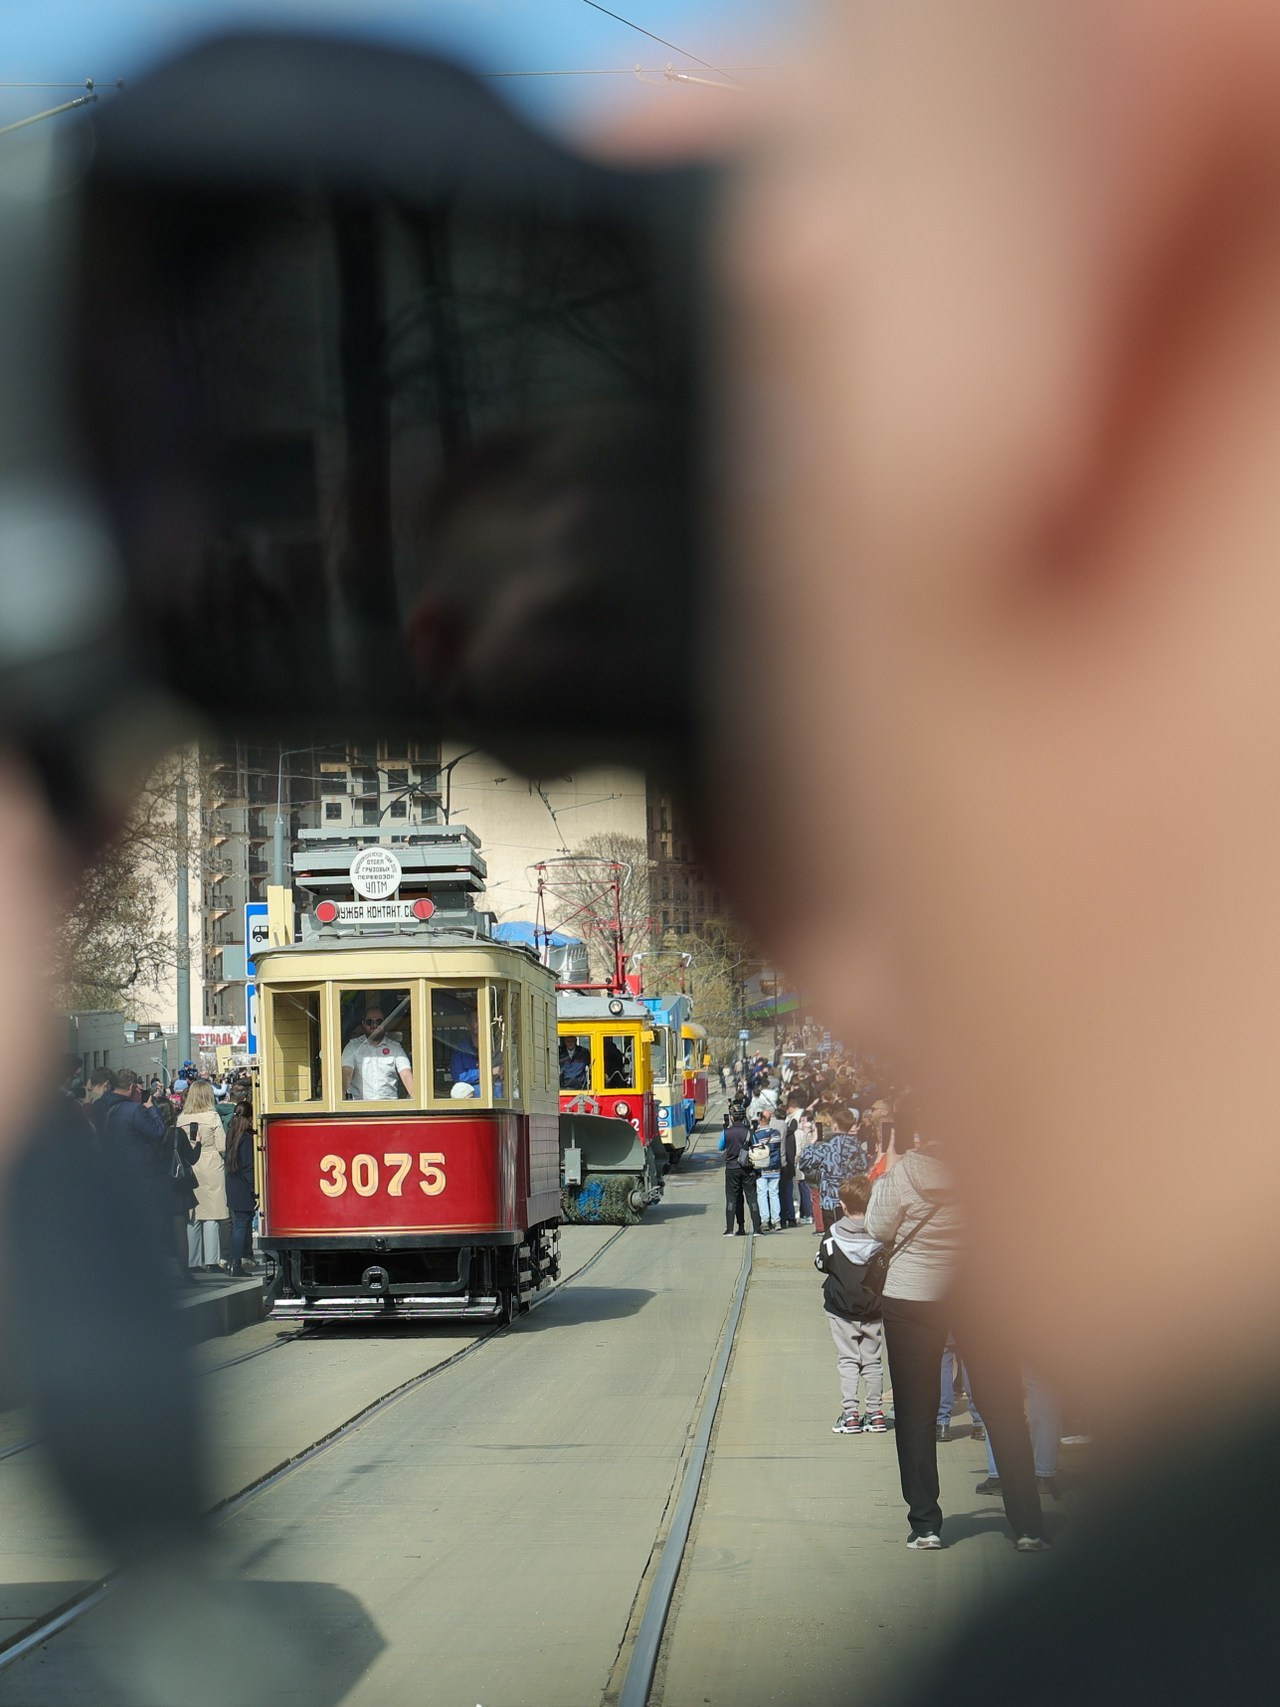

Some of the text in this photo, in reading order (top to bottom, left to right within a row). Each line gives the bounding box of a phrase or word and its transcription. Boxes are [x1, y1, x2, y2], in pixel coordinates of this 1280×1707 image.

[365, 881, 388, 894] УПТМ
[338, 906, 364, 919] УЖБА
[319, 1152, 446, 1198] 3075
